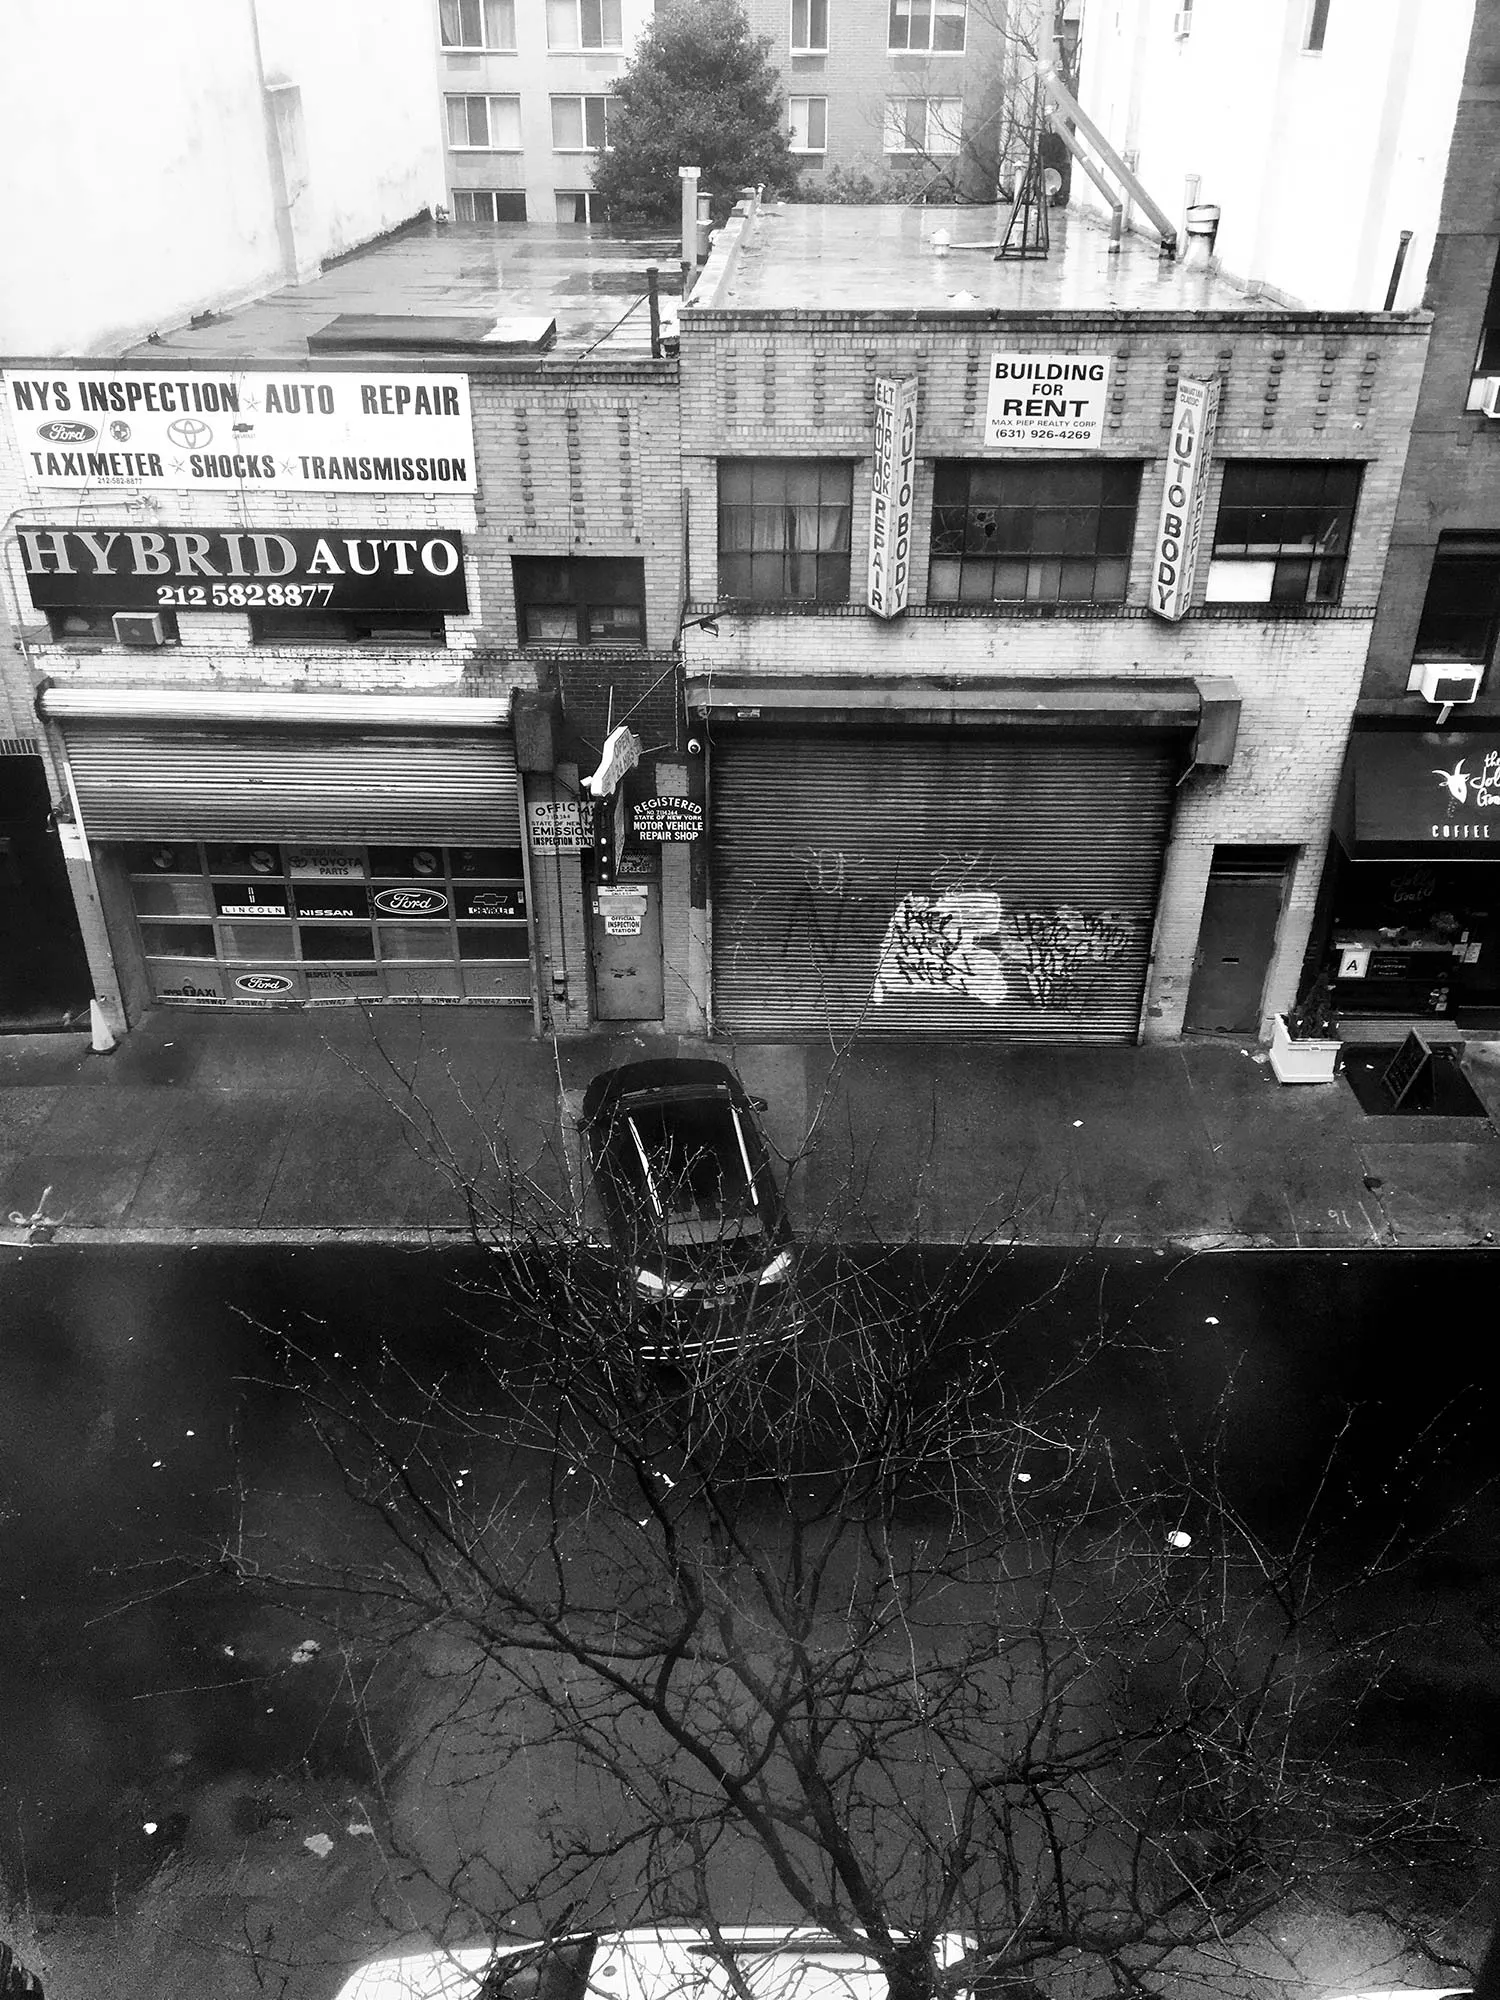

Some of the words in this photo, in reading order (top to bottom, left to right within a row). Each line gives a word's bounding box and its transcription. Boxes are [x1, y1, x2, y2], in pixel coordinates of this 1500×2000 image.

[995, 363, 1104, 380] BUILDING
[12, 381, 71, 411] NYS
[79, 381, 240, 412] INSPECTION
[266, 384, 335, 414] AUTO
[360, 385, 460, 415] REPAIR
[1032, 383, 1063, 396] FOR
[1003, 399, 1089, 417] RENT
[48, 423, 87, 442] Ford
[996, 429, 1026, 439] (631)
[1031, 430, 1091, 439] 926-4269
[874, 408, 884, 491] AUTO
[883, 411, 892, 495] TRUCK
[900, 407, 913, 507] AUTO
[1168, 408, 1195, 508] AUTO
[30, 452, 164, 477] TAXIMETER
[190, 454, 276, 478] SHOCKS
[298, 456, 467, 482] TRANSMISSION
[97, 476, 143, 485] 212-582-8877
[17, 531, 298, 577] HYBRID
[306, 538, 459, 576] AUTO
[871, 498, 886, 611] REPAIR
[895, 512, 909, 608] BODY
[1158, 513, 1182, 610] BODY
[156, 585, 207, 606] 212
[535, 802, 594, 817] OFFICA
[633, 796, 702, 815] REGISTERED
[532, 826, 594, 836] EMISSION
[633, 821, 664, 831] MOTOR
[665, 821, 704, 831] VEHICLE
[1432, 824, 1490, 838] COFFEE
[532, 837, 573, 846] INSPECTION
[575, 837, 595, 846] STATI
[640, 831, 672, 841] REPAIR
[674, 831, 699, 841] SHOP
[312, 857, 363, 868] TOYOTA
[319, 867, 349, 876] PARTS
[225, 906, 283, 914] LINCOLN
[390, 893, 432, 910] Ford
[299, 909, 354, 917] NISSAN
[1346, 959, 1358, 971] A
[247, 976, 280, 990] Ford
